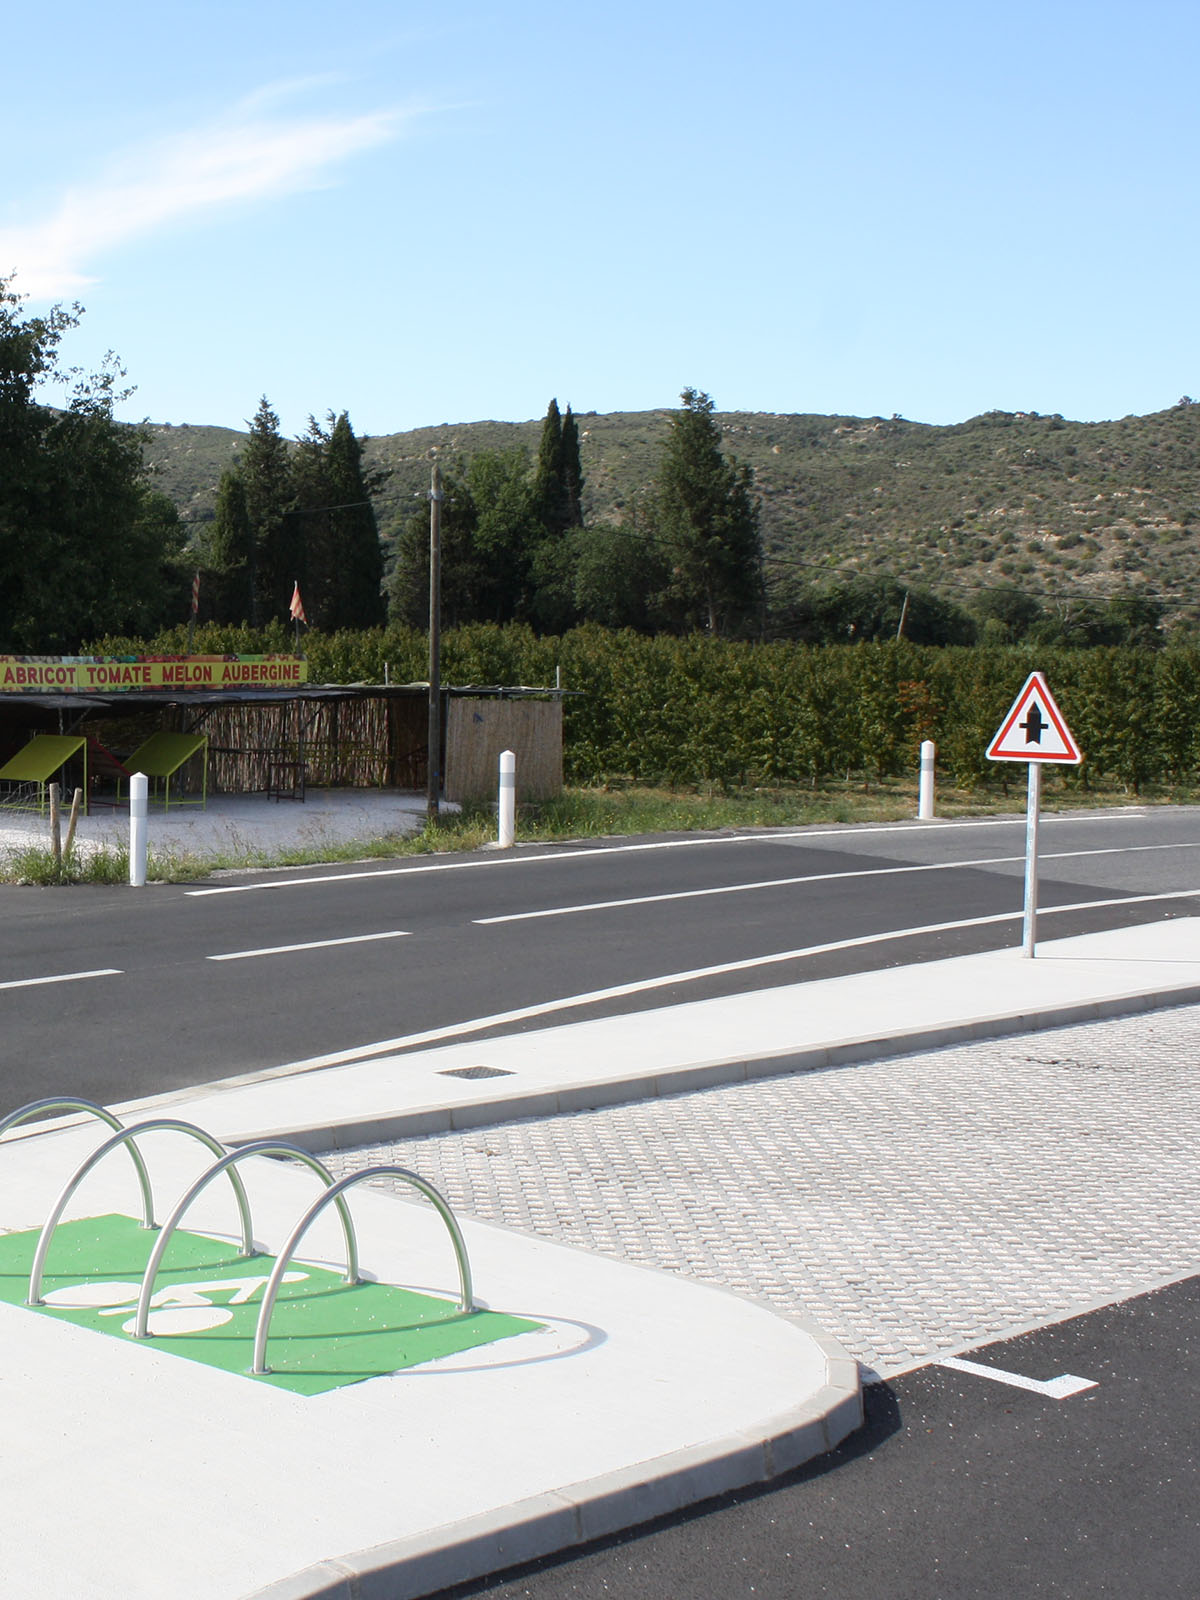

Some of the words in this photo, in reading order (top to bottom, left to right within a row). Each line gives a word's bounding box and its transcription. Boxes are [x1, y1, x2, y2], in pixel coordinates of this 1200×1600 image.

[4, 667, 76, 684] ABRICOT
[87, 666, 152, 683] TOMATE
[162, 665, 212, 682] MELON
[222, 664, 300, 681] AUBERGINE
